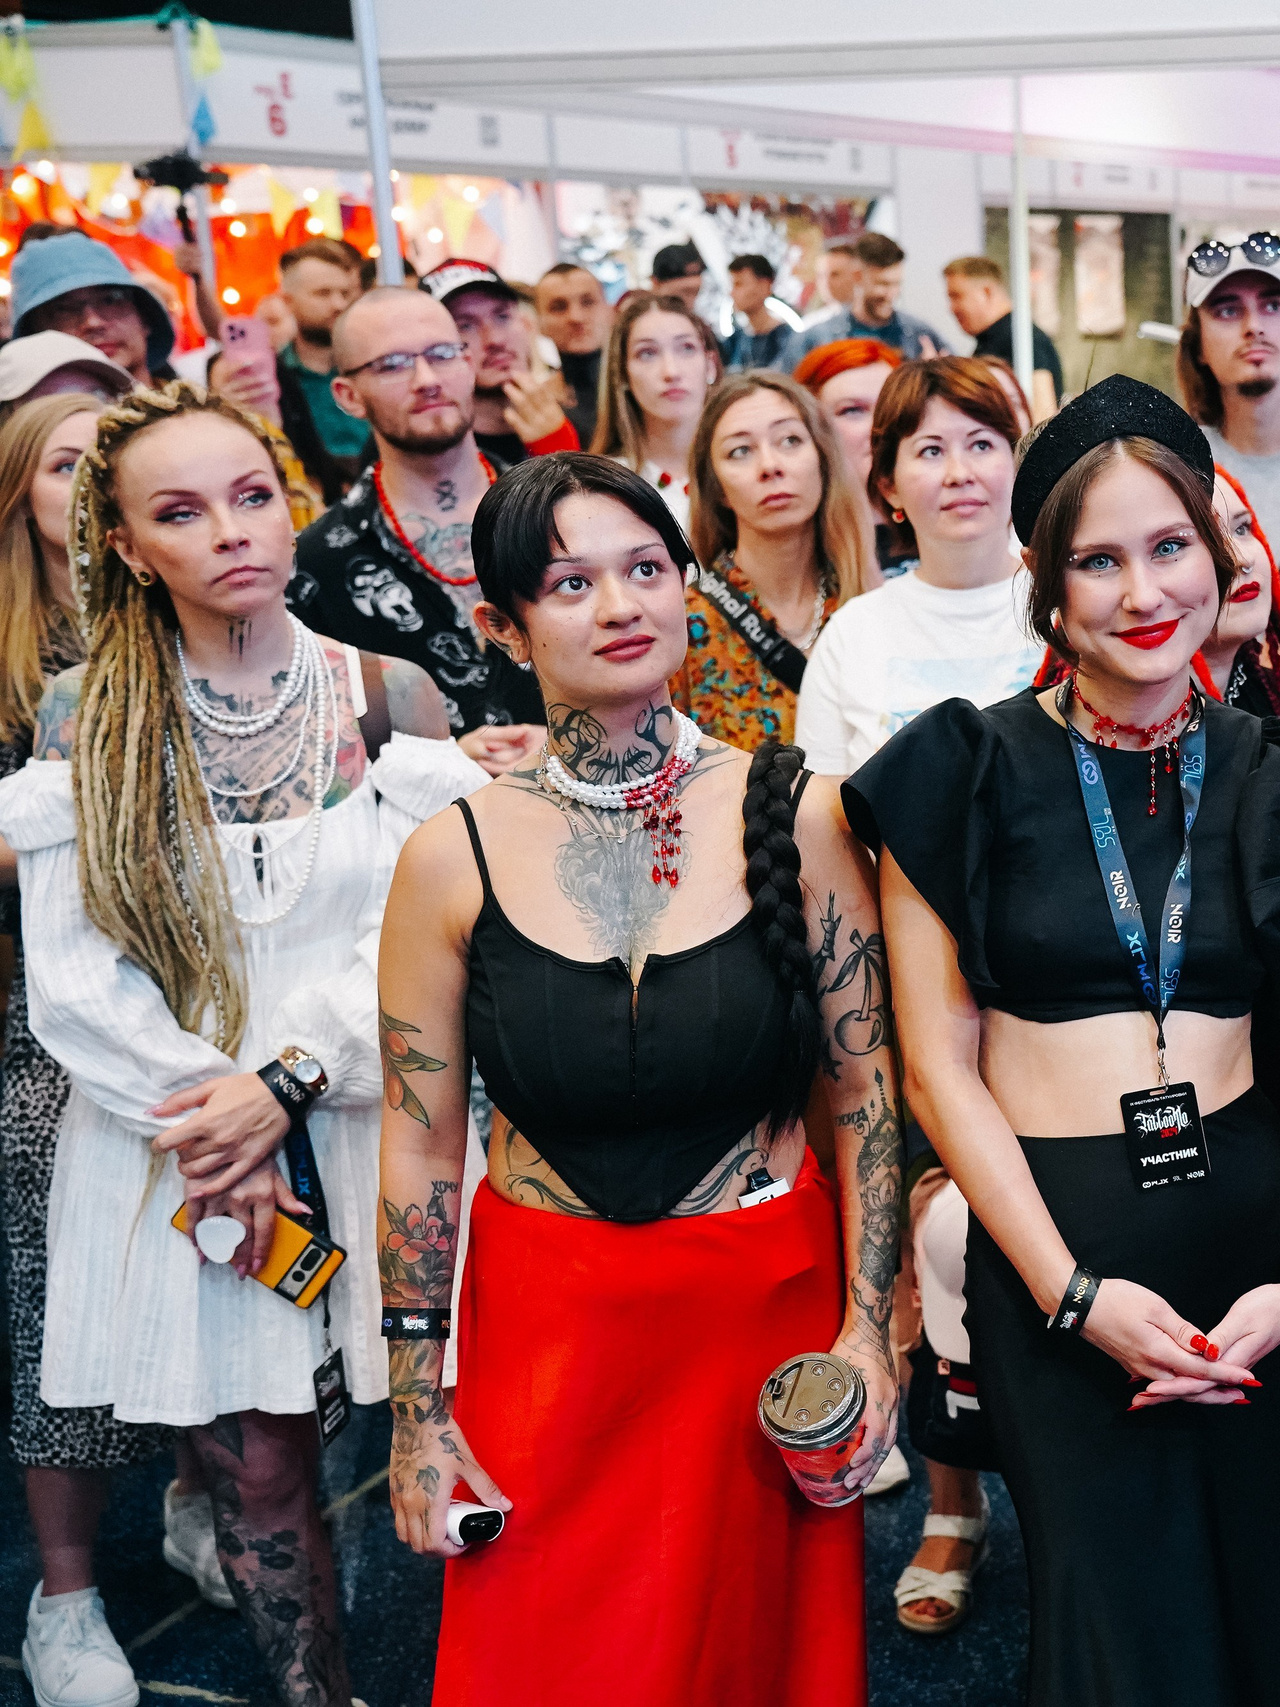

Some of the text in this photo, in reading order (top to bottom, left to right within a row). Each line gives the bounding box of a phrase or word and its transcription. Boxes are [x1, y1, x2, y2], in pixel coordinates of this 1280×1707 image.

[1109, 869, 1132, 910] NOIR
[1167, 903, 1184, 944] NOIR
[273, 1072, 306, 1103] NOIR
[1140, 1146, 1199, 1167] УЧАСТНИК
[1186, 1170, 1205, 1180] NOIR
[1072, 1277, 1091, 1304] NOIR
